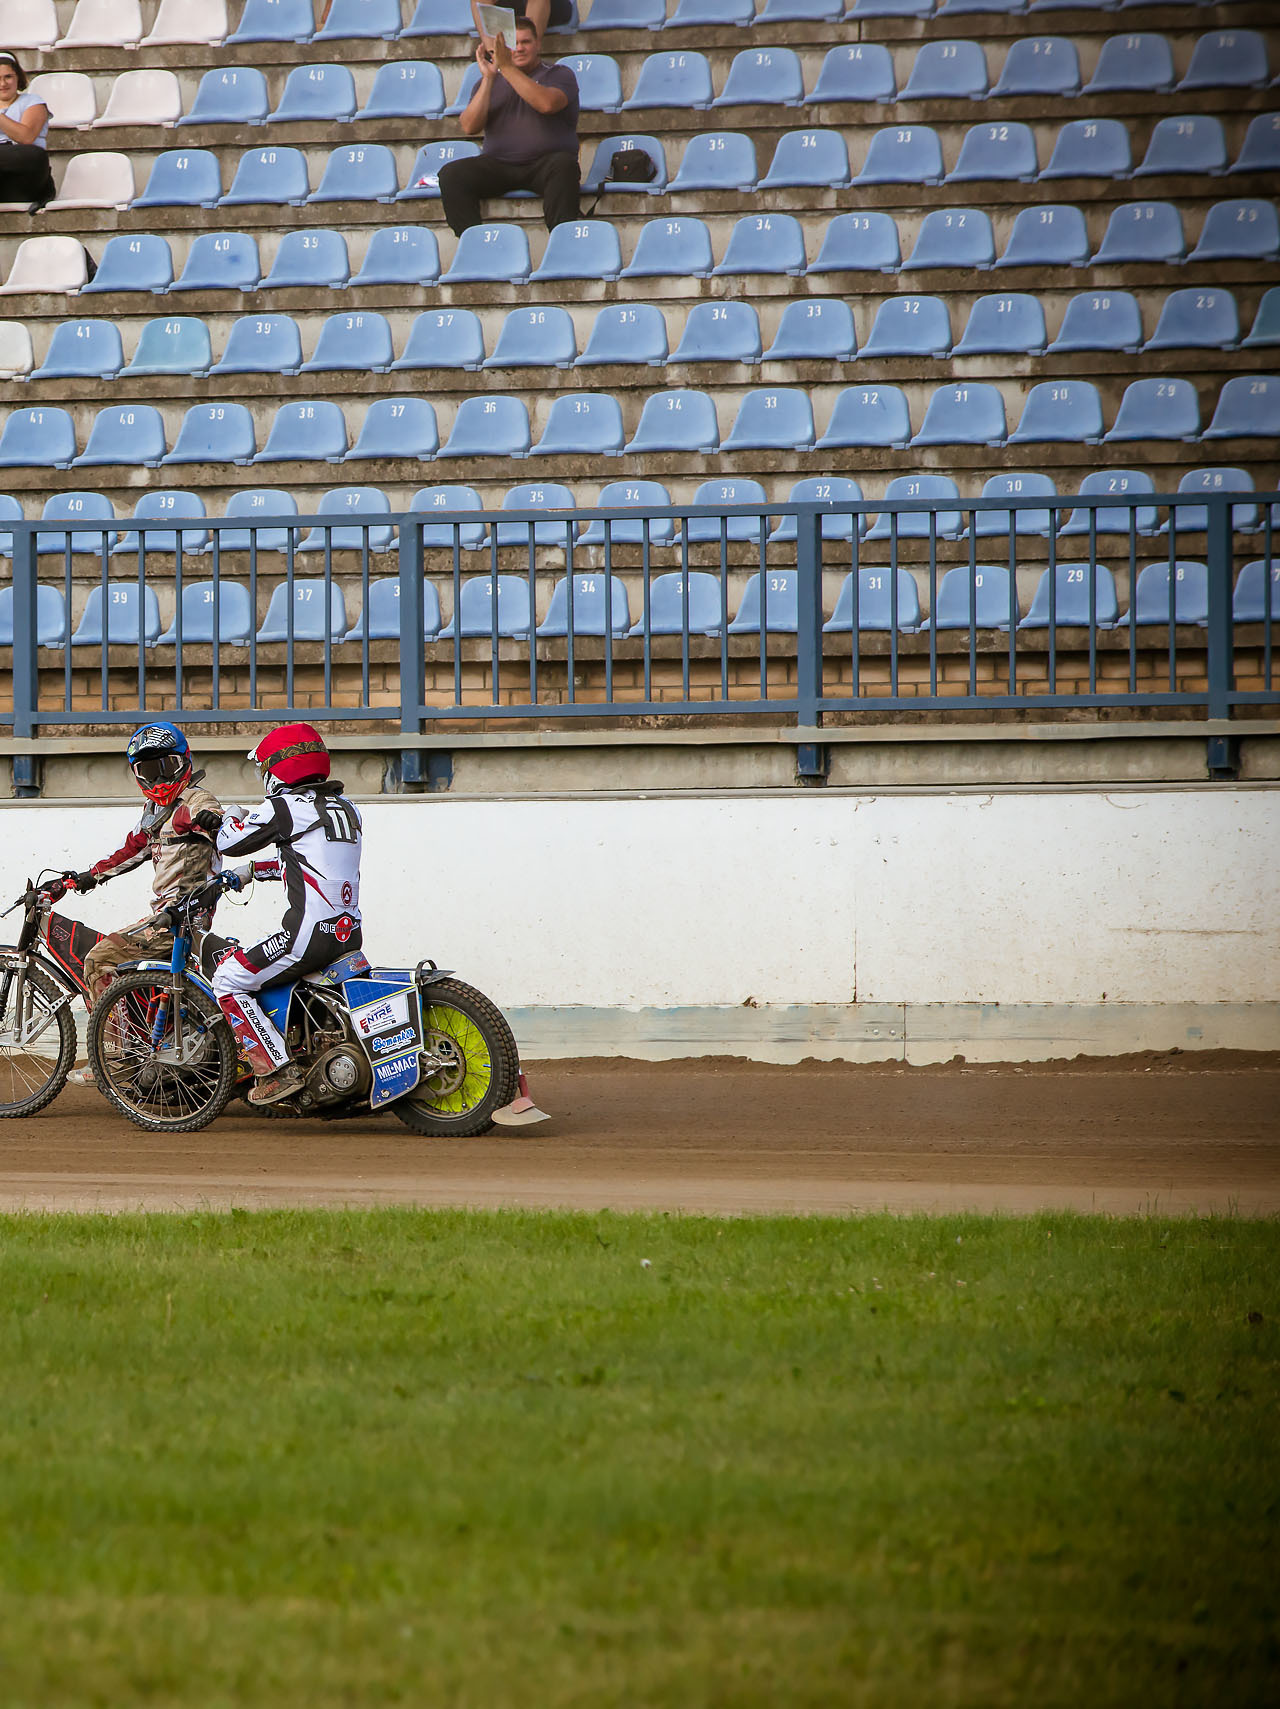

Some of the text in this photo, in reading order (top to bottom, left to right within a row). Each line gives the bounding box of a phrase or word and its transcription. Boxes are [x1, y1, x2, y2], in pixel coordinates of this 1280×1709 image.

[848, 47, 863, 61] 34
[942, 45, 957, 58] 33
[1033, 41, 1053, 55] 32
[576, 59, 593, 73] 37
[669, 55, 686, 69] 36
[756, 53, 772, 66] 35
[221, 72, 237, 85] 41
[309, 69, 325, 81] 40
[400, 67, 417, 80] 39
[896, 130, 912, 143] 33
[989, 126, 1009, 142] 32
[1083, 124, 1097, 139] 31
[619, 139, 635, 152] 36
[708, 138, 725, 152] 35
[801, 135, 817, 148] 34
[259, 151, 277, 164] 40
[347, 150, 365, 163] 39
[438, 147, 455, 160] 38
[176, 157, 189, 170] 41
[945, 214, 966, 228] 32
[1039, 210, 1054, 225] 31
[1133, 207, 1154, 221] 30
[1236, 207, 1258, 223] 29
[666, 222, 681, 235] 35
[756, 218, 772, 231] 34
[852, 217, 870, 230] 33
[393, 230, 409, 243] 38
[483, 229, 500, 243] 37
[574, 225, 589, 239] 36
[129, 241, 141, 253] 41
[214, 238, 230, 252] 40
[303, 236, 319, 249] 39
[903, 300, 920, 315] 32
[997, 300, 1013, 313] 31
[1092, 297, 1111, 311] 30
[1195, 295, 1215, 309] 29
[529, 311, 545, 325] 36
[619, 310, 636, 324] 35
[711, 307, 728, 321] 34
[807, 304, 822, 318] 33
[164, 321, 181, 335] 40
[255, 321, 272, 335] 39
[346, 316, 364, 330] 38
[436, 314, 454, 328] 37
[76, 325, 90, 339] 41
[954, 390, 968, 403] 31
[1051, 387, 1068, 401] 30
[1156, 383, 1177, 398] 29
[667, 398, 682, 411] 34
[764, 396, 777, 409] 33
[862, 391, 879, 405] 32
[208, 408, 225, 421] 39
[298, 407, 315, 419] 38
[391, 404, 406, 417] 37
[483, 401, 497, 414] 36
[574, 401, 590, 414] 35
[29, 411, 44, 425] 41
[119, 412, 135, 425] 40
[1006, 479, 1022, 493] 30
[1108, 478, 1128, 492] 29
[1202, 472, 1223, 487] 28
[624, 488, 640, 501] 34
[720, 487, 735, 499] 33
[815, 484, 831, 498] 32
[908, 482, 920, 496] 31
[159, 495, 175, 509] 39
[250, 495, 265, 507] 38
[345, 493, 361, 506] 37
[433, 493, 447, 506] 36
[529, 490, 544, 503] 35
[67, 498, 83, 512] 40
[868, 576, 882, 590] 31
[1066, 569, 1084, 583] 29
[581, 579, 596, 593] 34
[771, 578, 787, 593] 32
[112, 591, 128, 604] 39
[297, 588, 313, 601] 37
